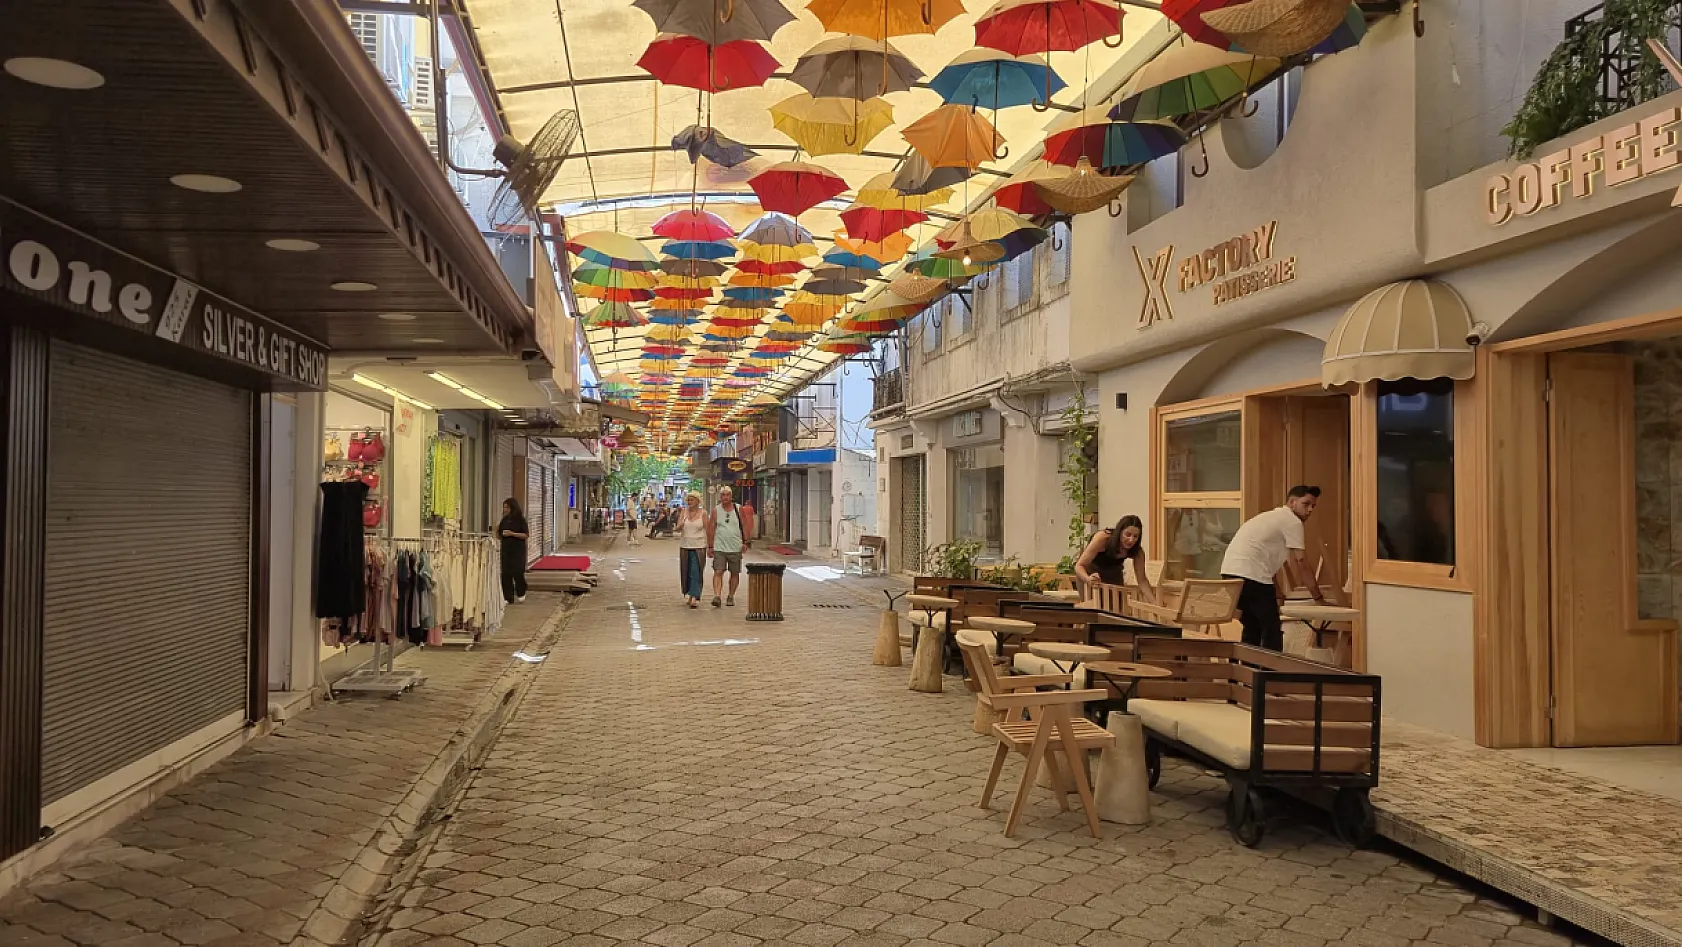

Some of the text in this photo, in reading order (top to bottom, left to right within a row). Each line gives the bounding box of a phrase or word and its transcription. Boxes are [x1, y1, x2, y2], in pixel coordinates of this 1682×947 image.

[1486, 107, 1682, 225] COFFEE
[9, 239, 152, 325] one
[1177, 220, 1278, 293] FACTORY
[1212, 256, 1296, 305] PATISSERIE
[203, 304, 256, 364] SILVER
[258, 326, 268, 368] &
[270, 332, 297, 377] GIFT
[298, 344, 325, 386] SHOP
